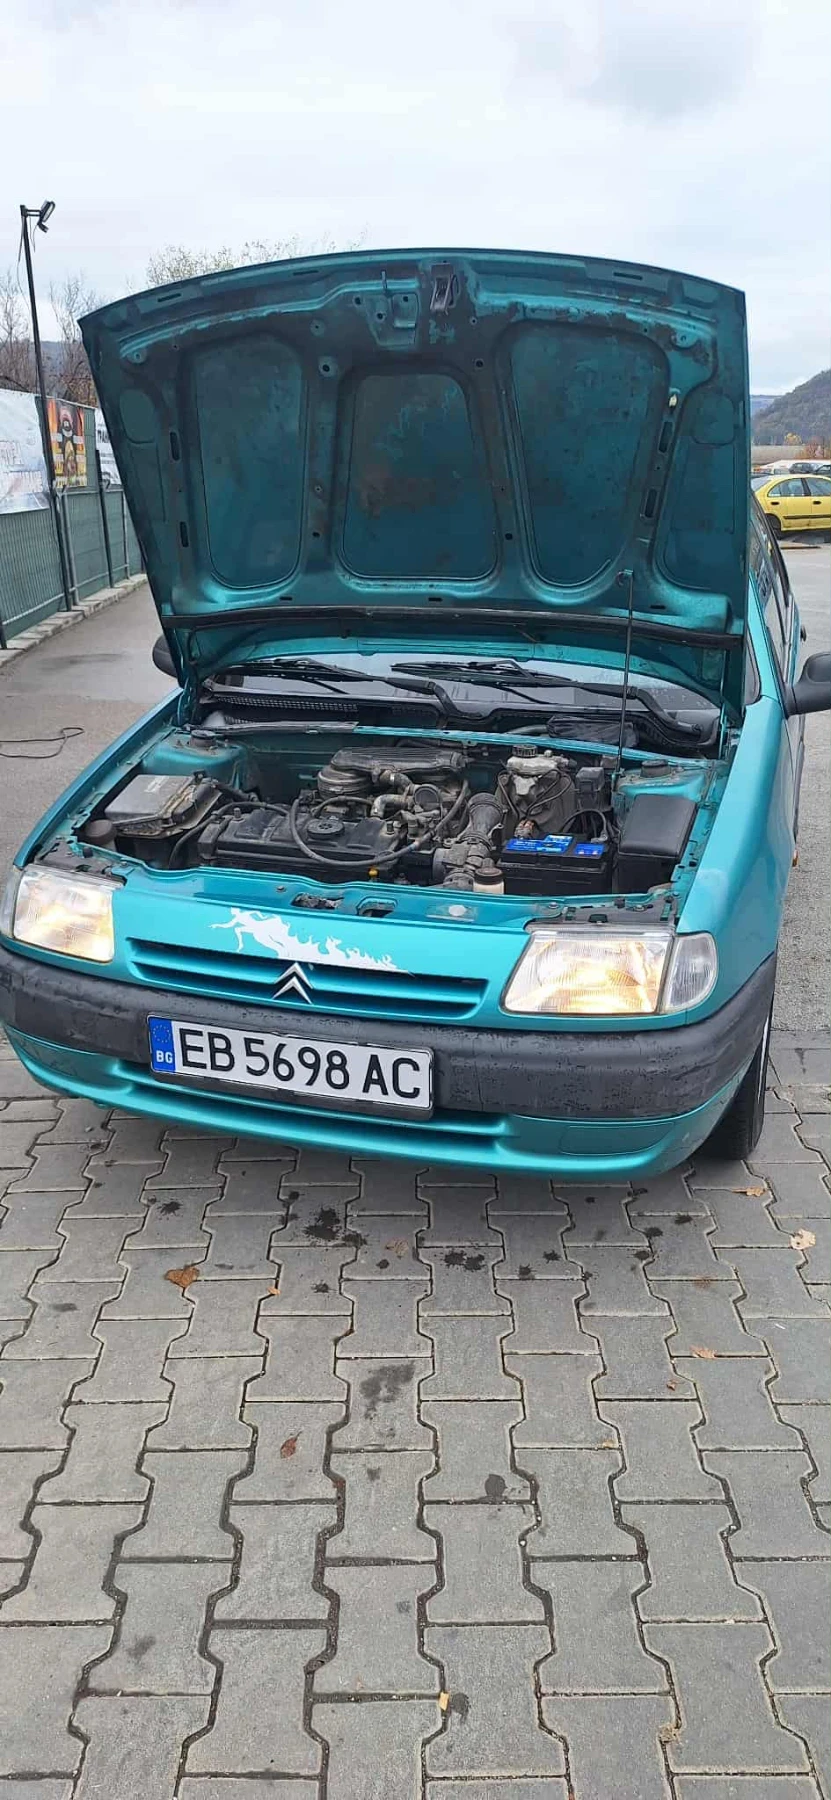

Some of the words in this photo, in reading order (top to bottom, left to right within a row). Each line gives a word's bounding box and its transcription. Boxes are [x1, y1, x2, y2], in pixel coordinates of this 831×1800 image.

[156, 1050, 173, 1064] BG
[179, 1028, 235, 1072] EB
[244, 1037, 350, 1090] 5698
[362, 1054, 421, 1100] AC
